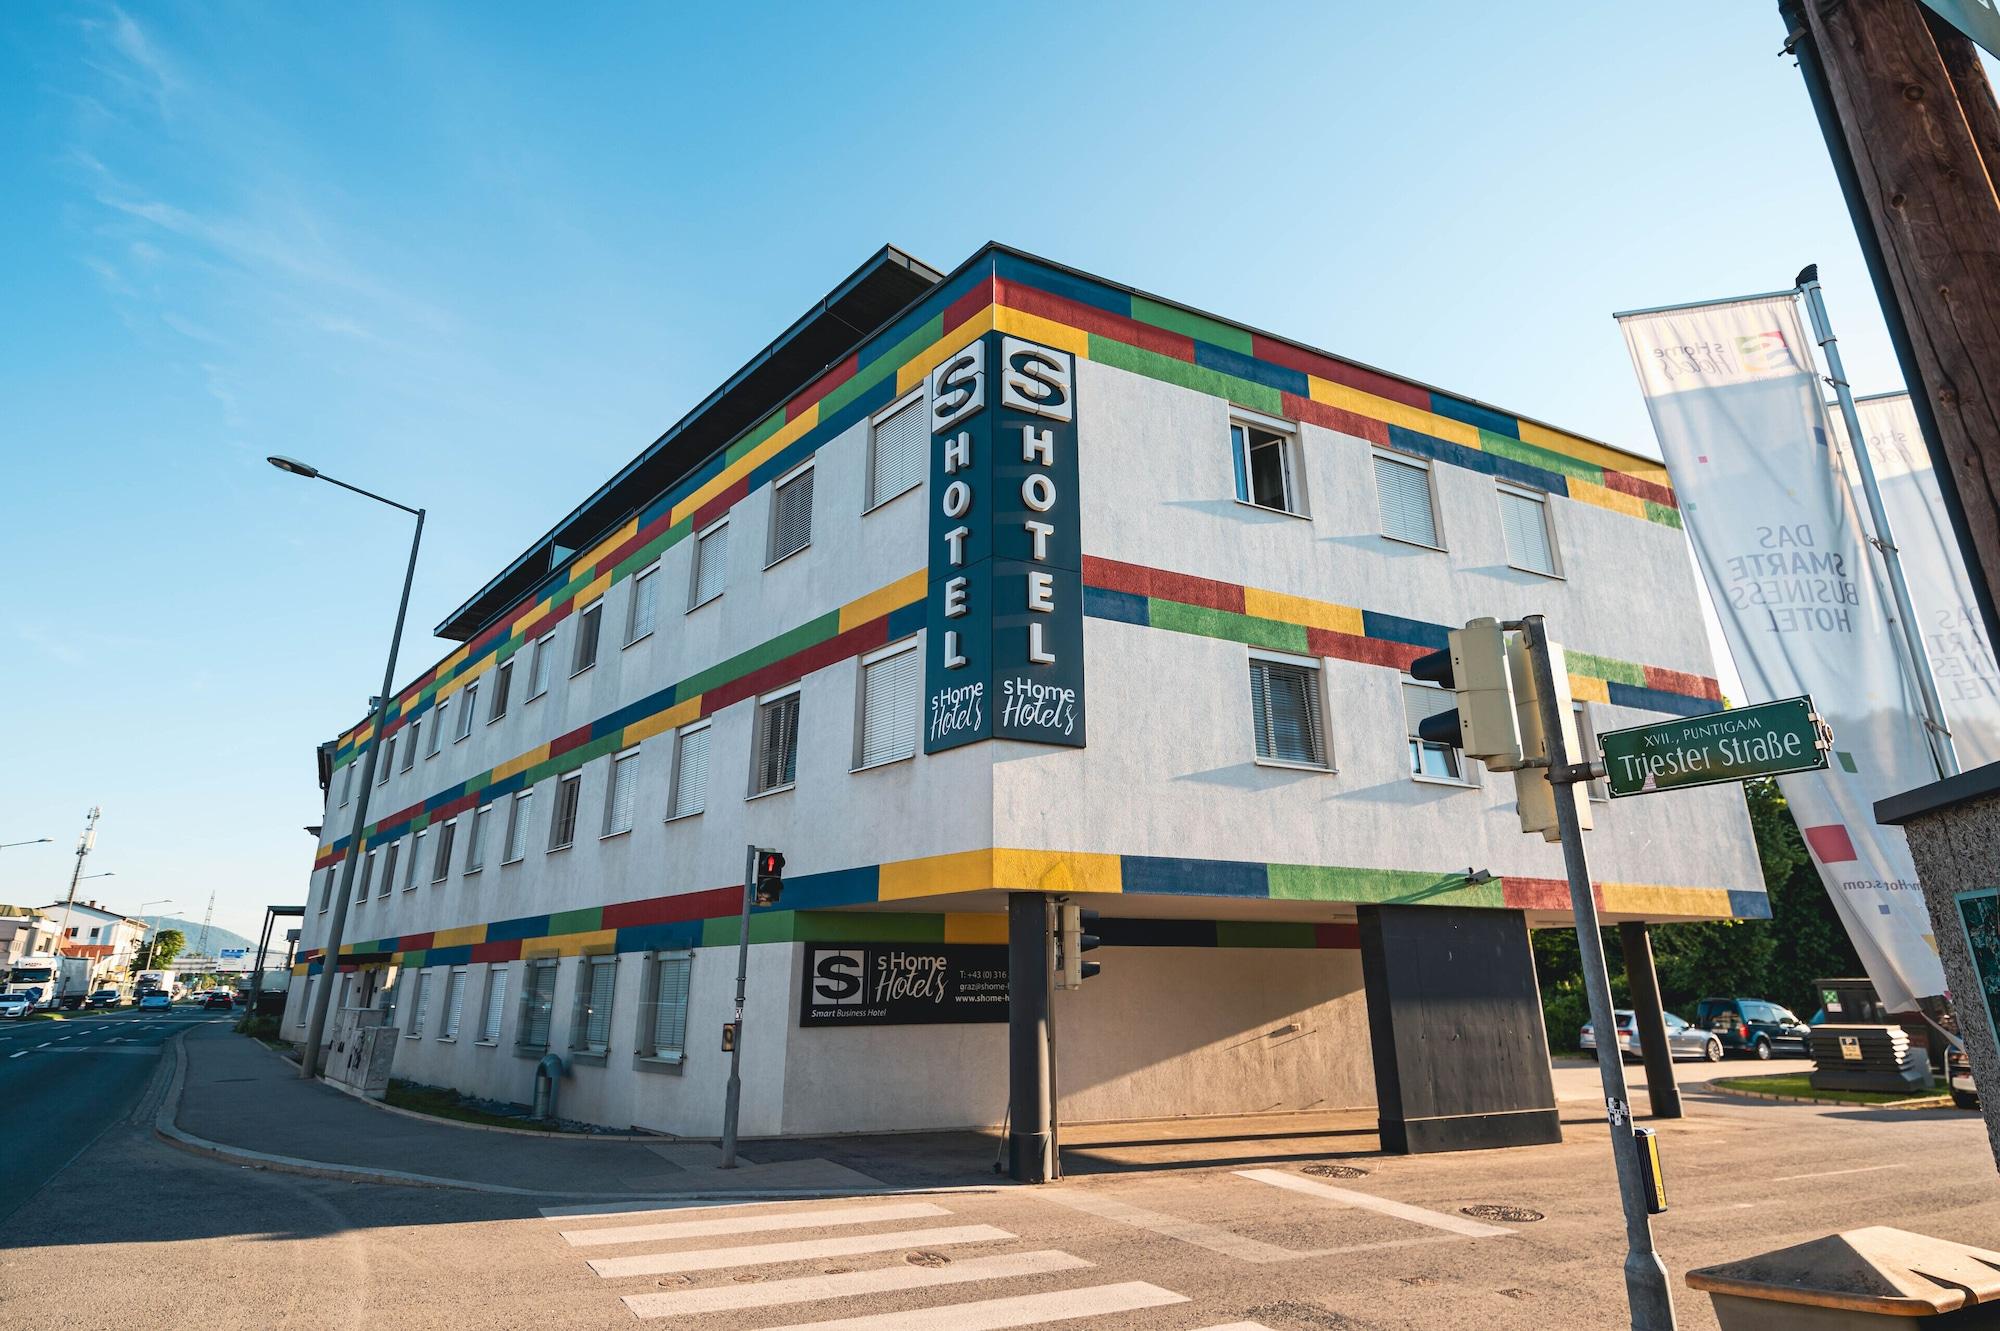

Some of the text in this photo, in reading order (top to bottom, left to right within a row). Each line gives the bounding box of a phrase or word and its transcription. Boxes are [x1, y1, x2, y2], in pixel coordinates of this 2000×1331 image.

[934, 353, 979, 668] S HOTEL
[1008, 347, 1069, 664] S HOTEL
[932, 682, 983, 710] sHome
[1003, 677, 1075, 704] sHome
[1683, 718, 1762, 741] PUNTIGAM
[1617, 731, 1801, 782] Triester Straße
[877, 952, 947, 970] sHome
[993, 970, 1007, 979] 316
[814, 954, 862, 1001] S
[811, 1008, 887, 1018] Smart Business Hotel
